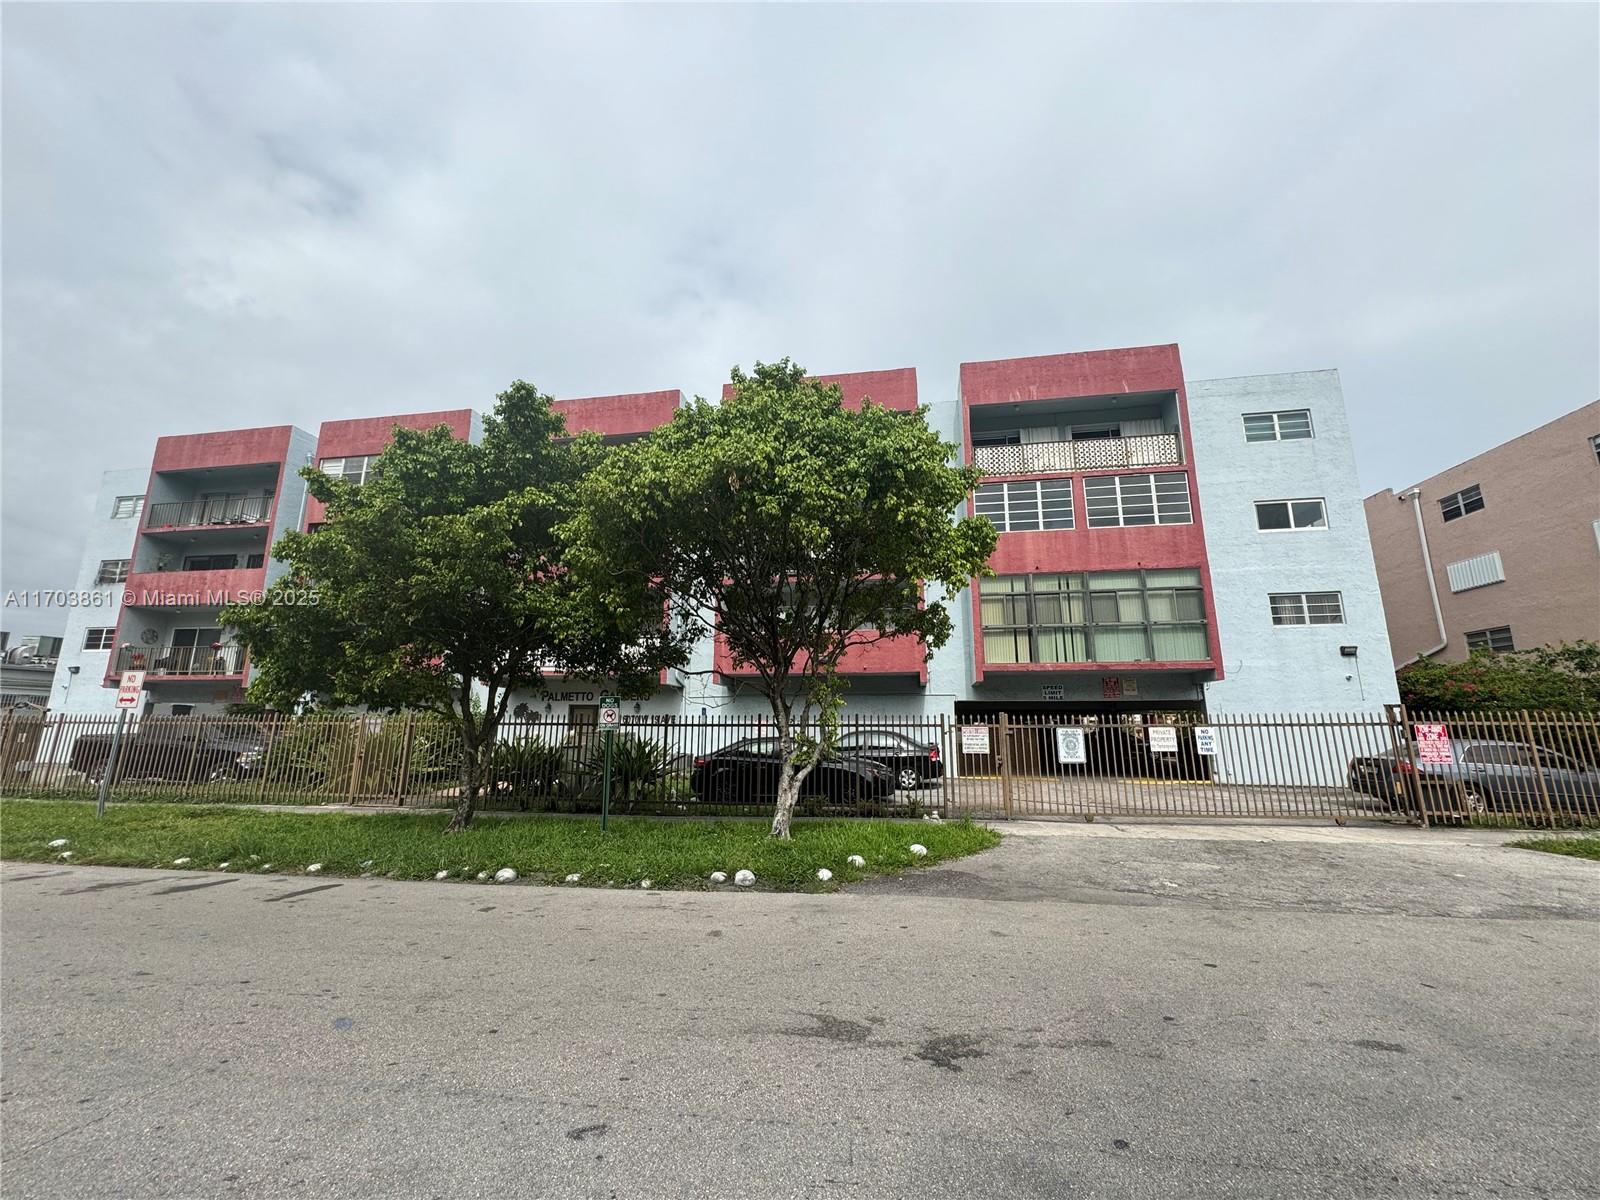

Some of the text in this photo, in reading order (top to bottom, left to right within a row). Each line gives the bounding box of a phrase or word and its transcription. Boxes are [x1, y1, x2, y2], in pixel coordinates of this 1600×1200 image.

[128, 675, 137, 683] NO
[120, 685, 140, 693] PARKING
[541, 690, 594, 702] PALMETTO
